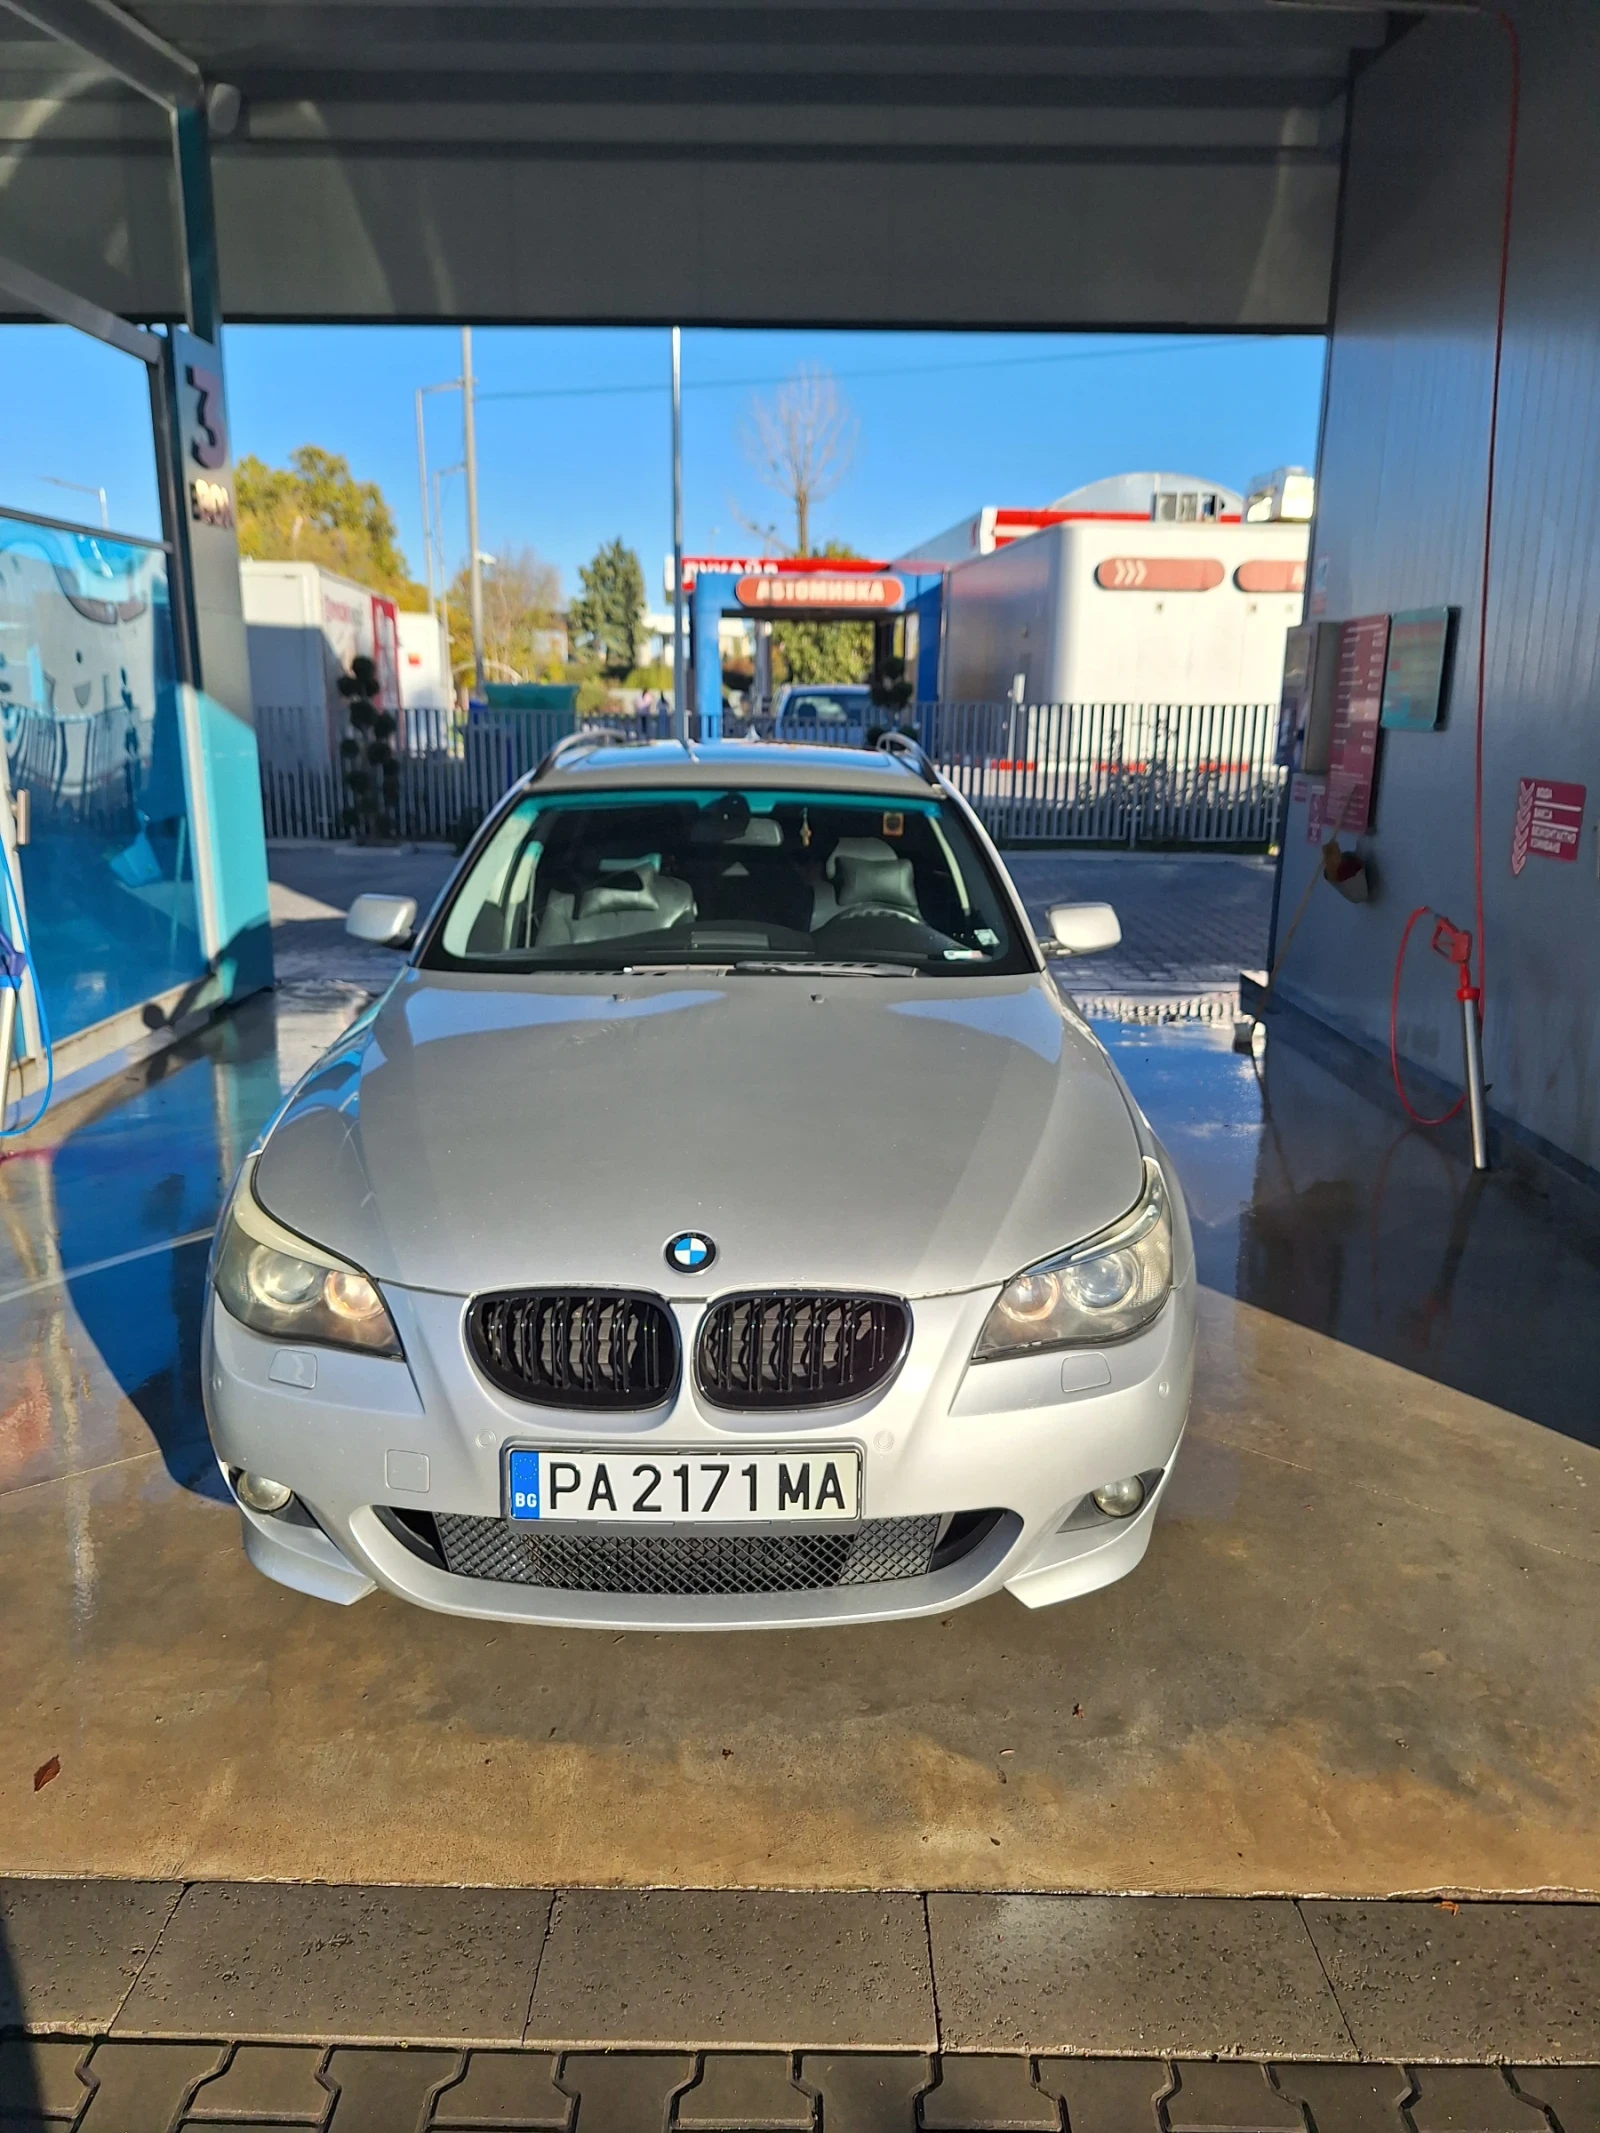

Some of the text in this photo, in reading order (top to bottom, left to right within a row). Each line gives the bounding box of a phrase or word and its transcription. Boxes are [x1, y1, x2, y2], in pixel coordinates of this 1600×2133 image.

[187, 365, 227, 470] 3
[515, 1461, 846, 1513] BG PA 2171 MA
